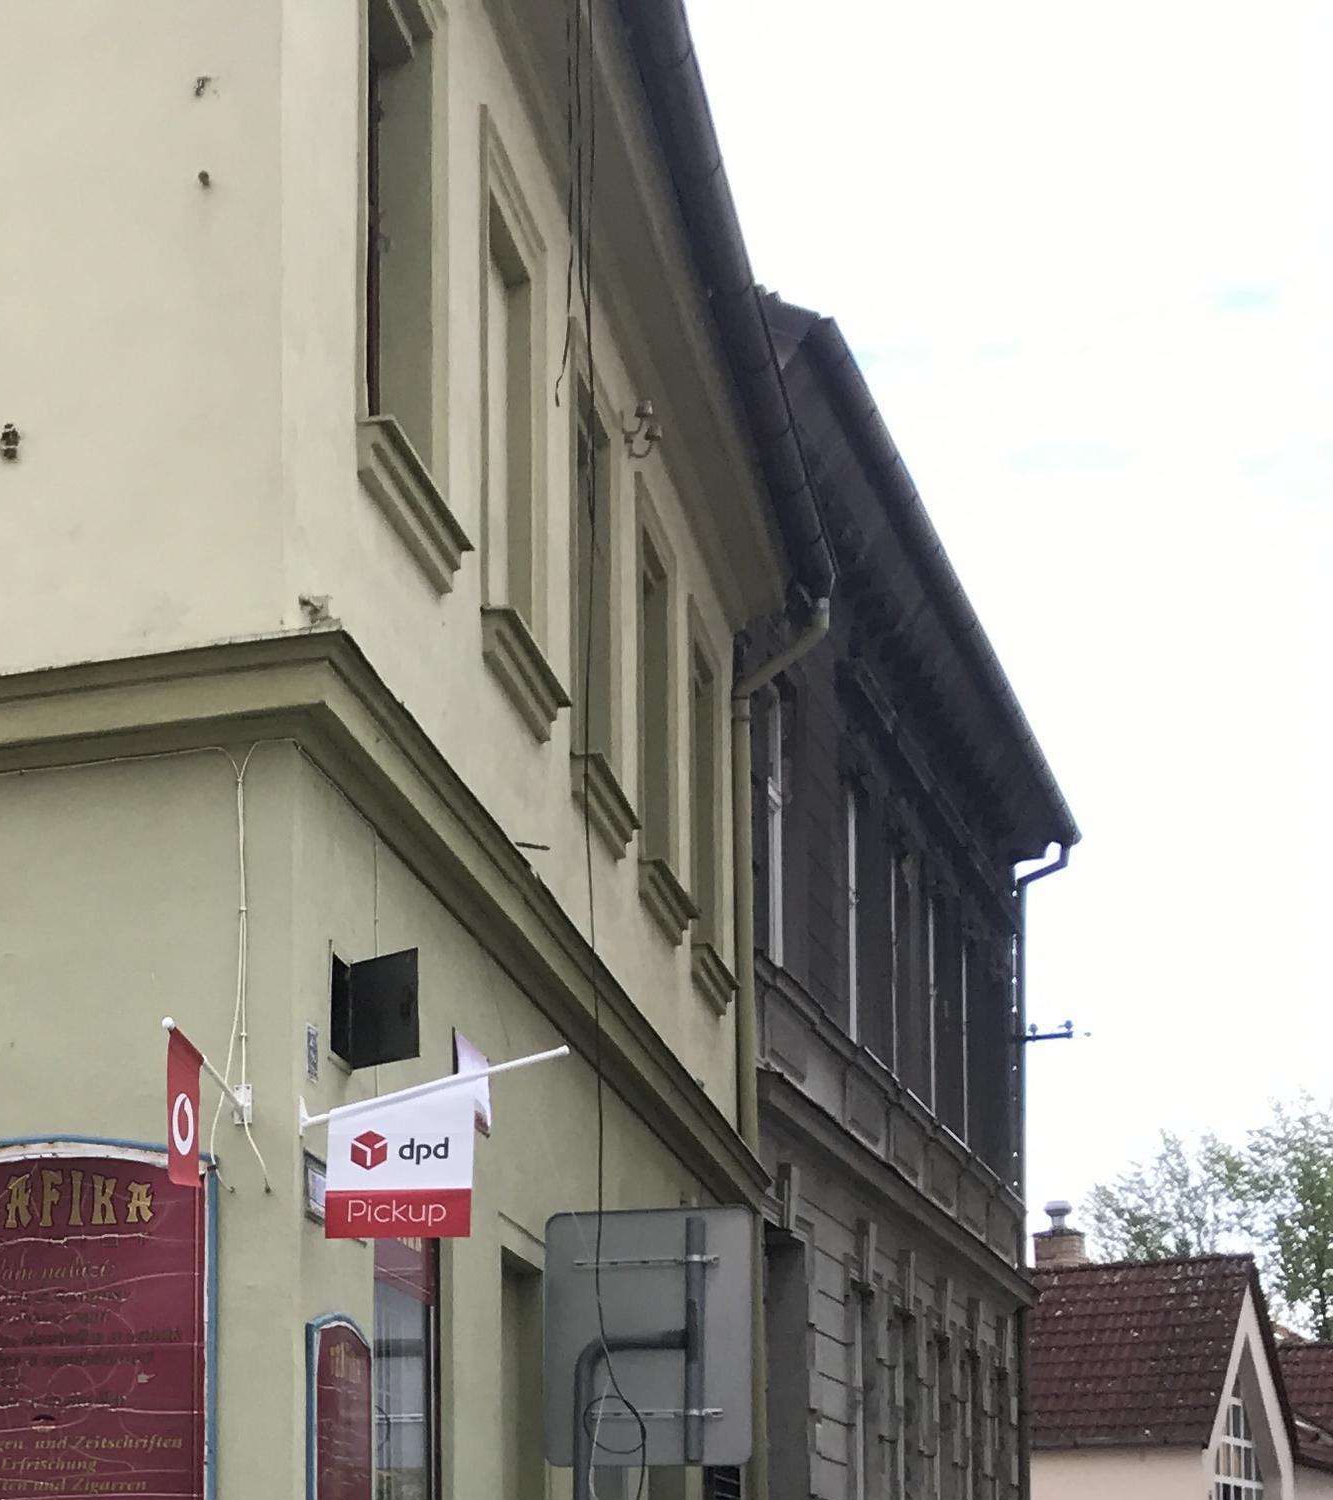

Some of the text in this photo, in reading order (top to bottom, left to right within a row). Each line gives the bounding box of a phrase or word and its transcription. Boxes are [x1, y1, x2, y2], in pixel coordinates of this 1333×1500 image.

[398, 1137, 449, 1165] dpd
[347, 1199, 447, 1227] Pickup
[36, 1437, 68, 1450] und
[71, 1434, 183, 1453] Zeitschriften
[1, 1456, 98, 1473] Erfrischung
[71, 1478, 147, 1495] Zigarren
